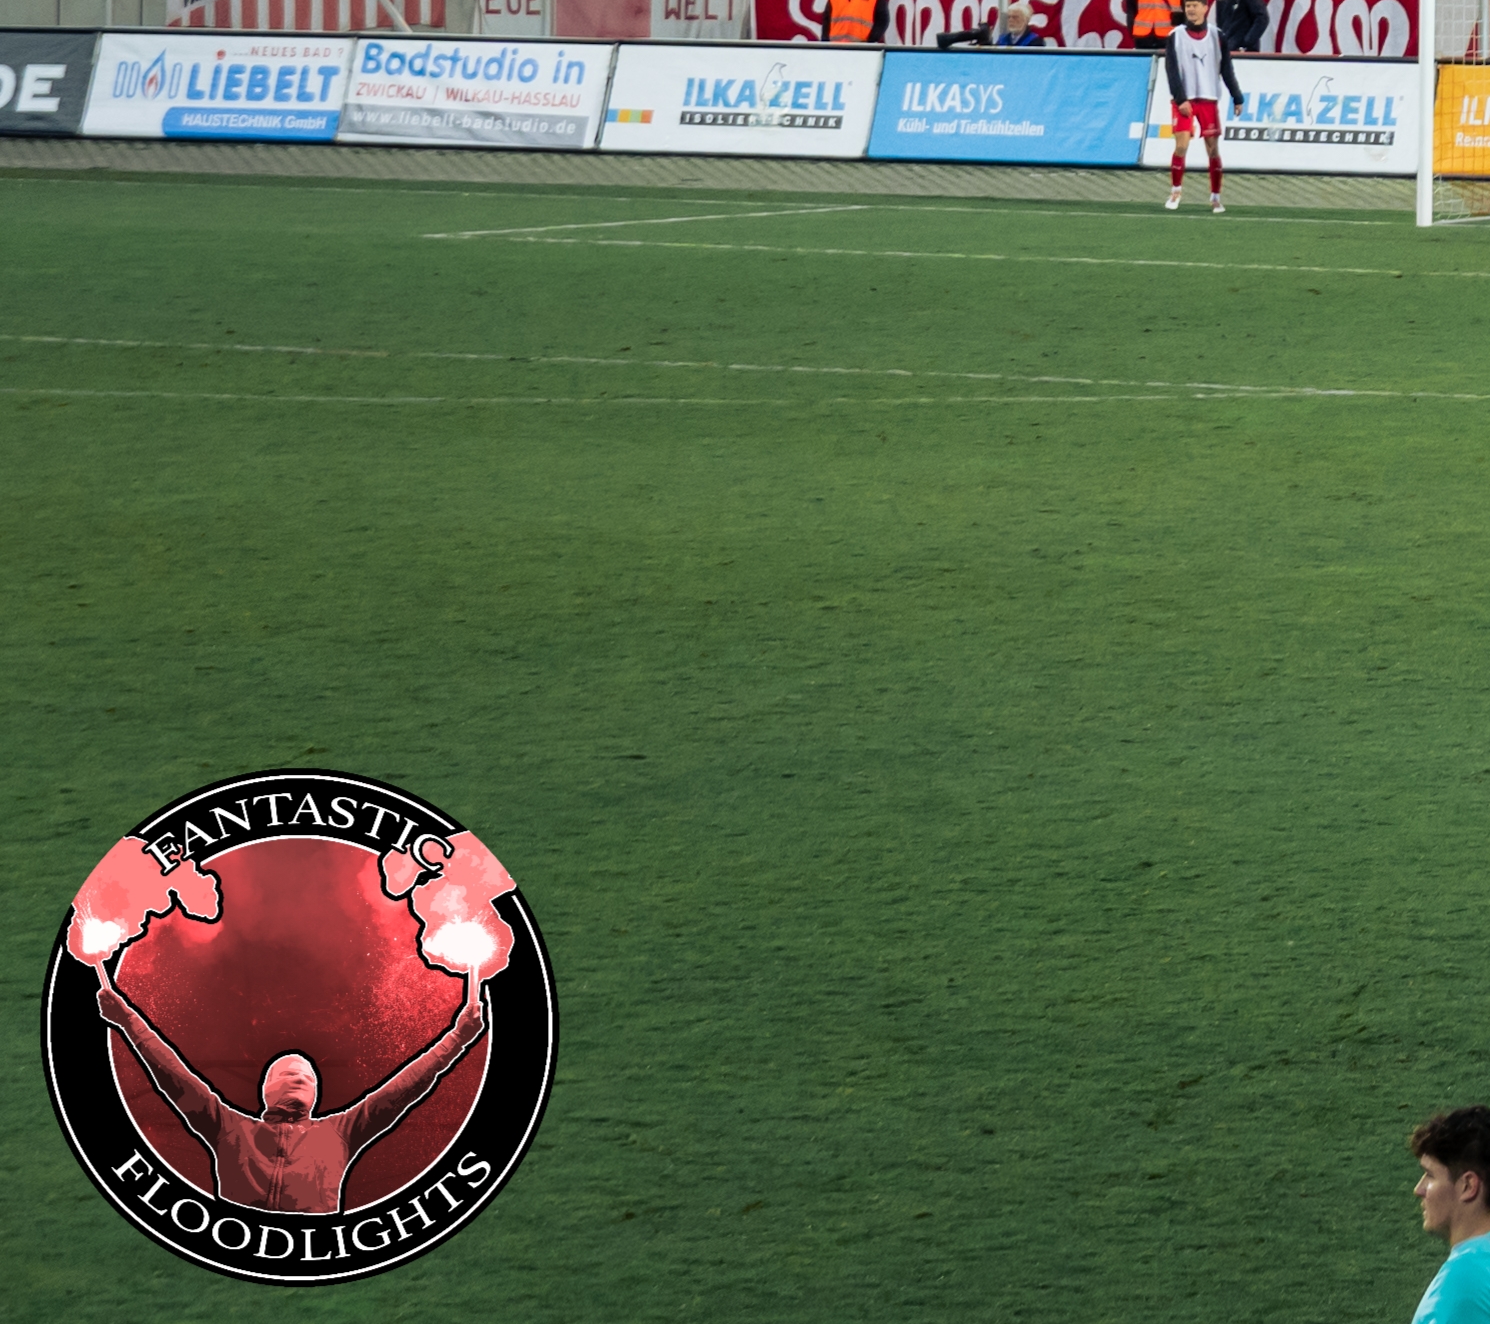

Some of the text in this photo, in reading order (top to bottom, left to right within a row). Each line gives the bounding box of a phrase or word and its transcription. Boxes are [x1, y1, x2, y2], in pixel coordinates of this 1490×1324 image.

[360, 43, 586, 85] Badstudio in
[355, 83, 581, 108] ZWICKAU WILKAU-HASSLAU
[903, 82, 1004, 114] ILKASYS
[181, 113, 326, 130] HAUSTECHNIK GmbH
[352, 110, 577, 135] www.liebelt-badstudio.de
[1318, 94, 1398, 126] ZELL
[898, 117, 1044, 136] Kühl- und Tiefkühlzellen
[1228, 127, 1393, 145] ISOLIERTECHNIK
